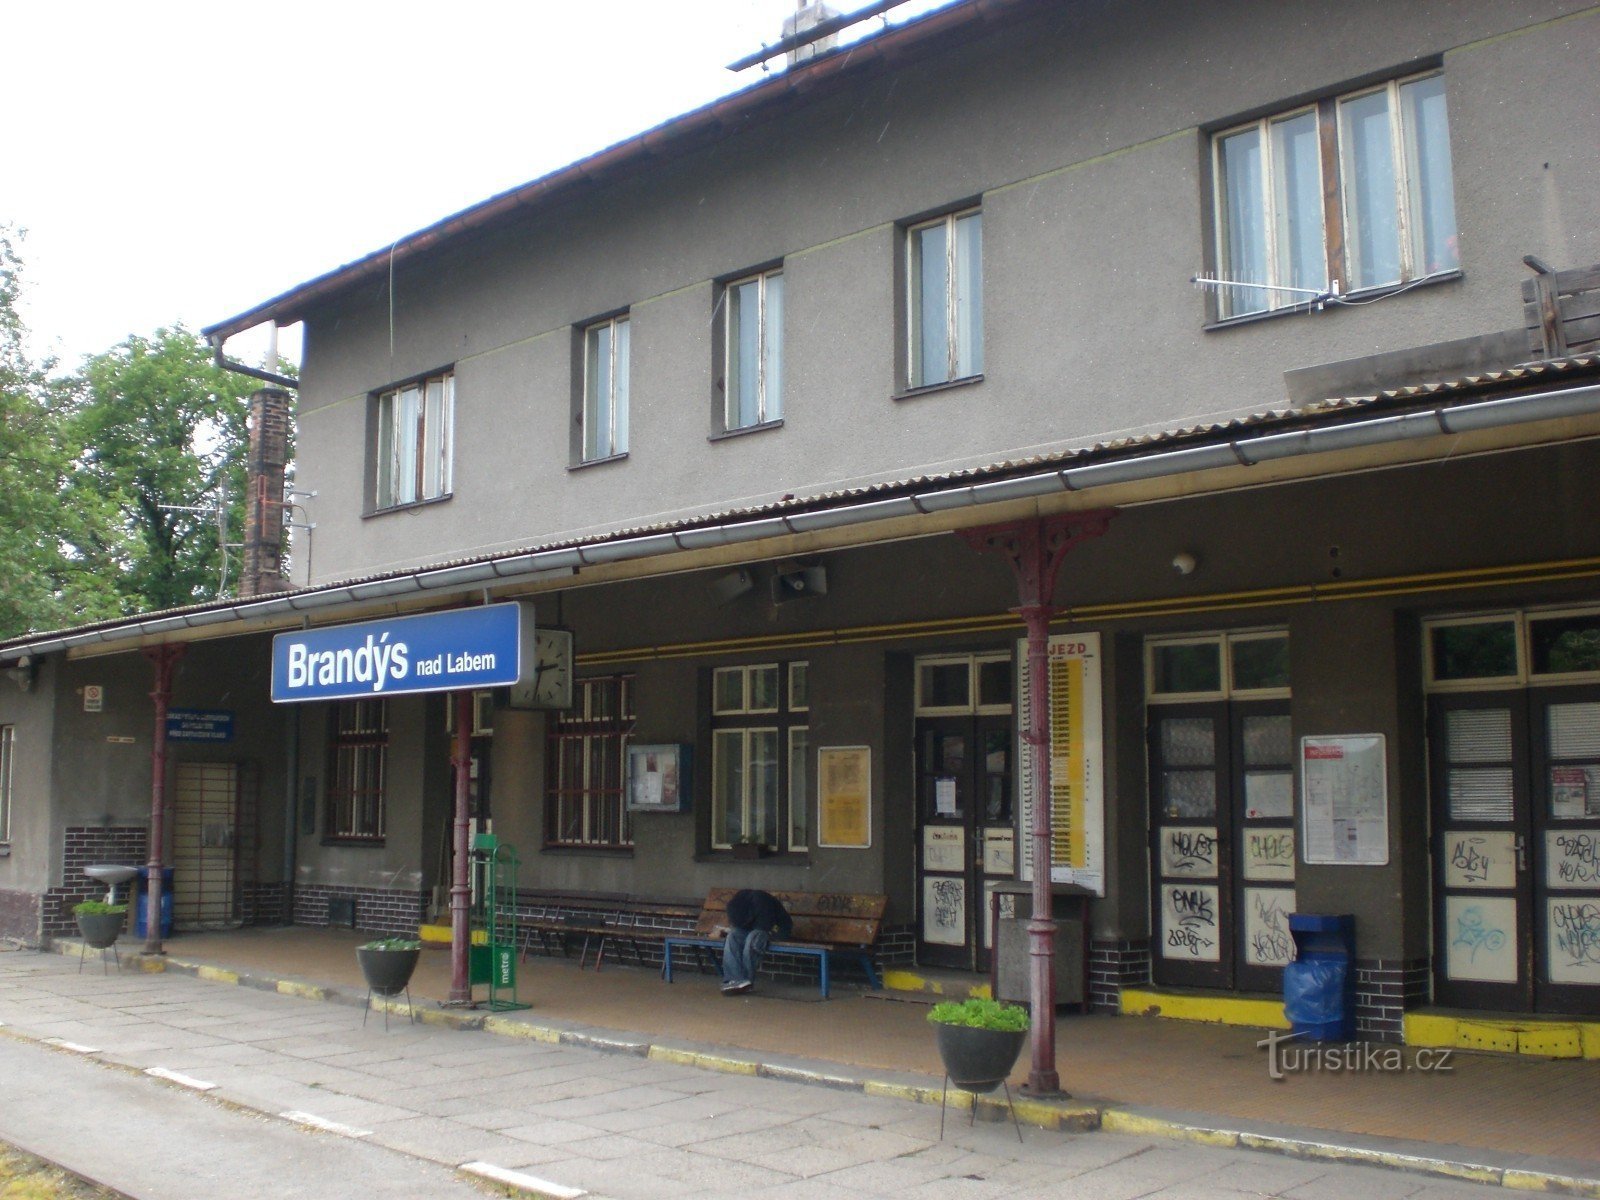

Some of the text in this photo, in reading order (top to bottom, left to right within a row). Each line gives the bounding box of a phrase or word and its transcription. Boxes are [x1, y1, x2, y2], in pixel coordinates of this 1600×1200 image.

[288, 632, 496, 691] Brandýs nad Labem
[1027, 642, 1087, 656] JEZD
